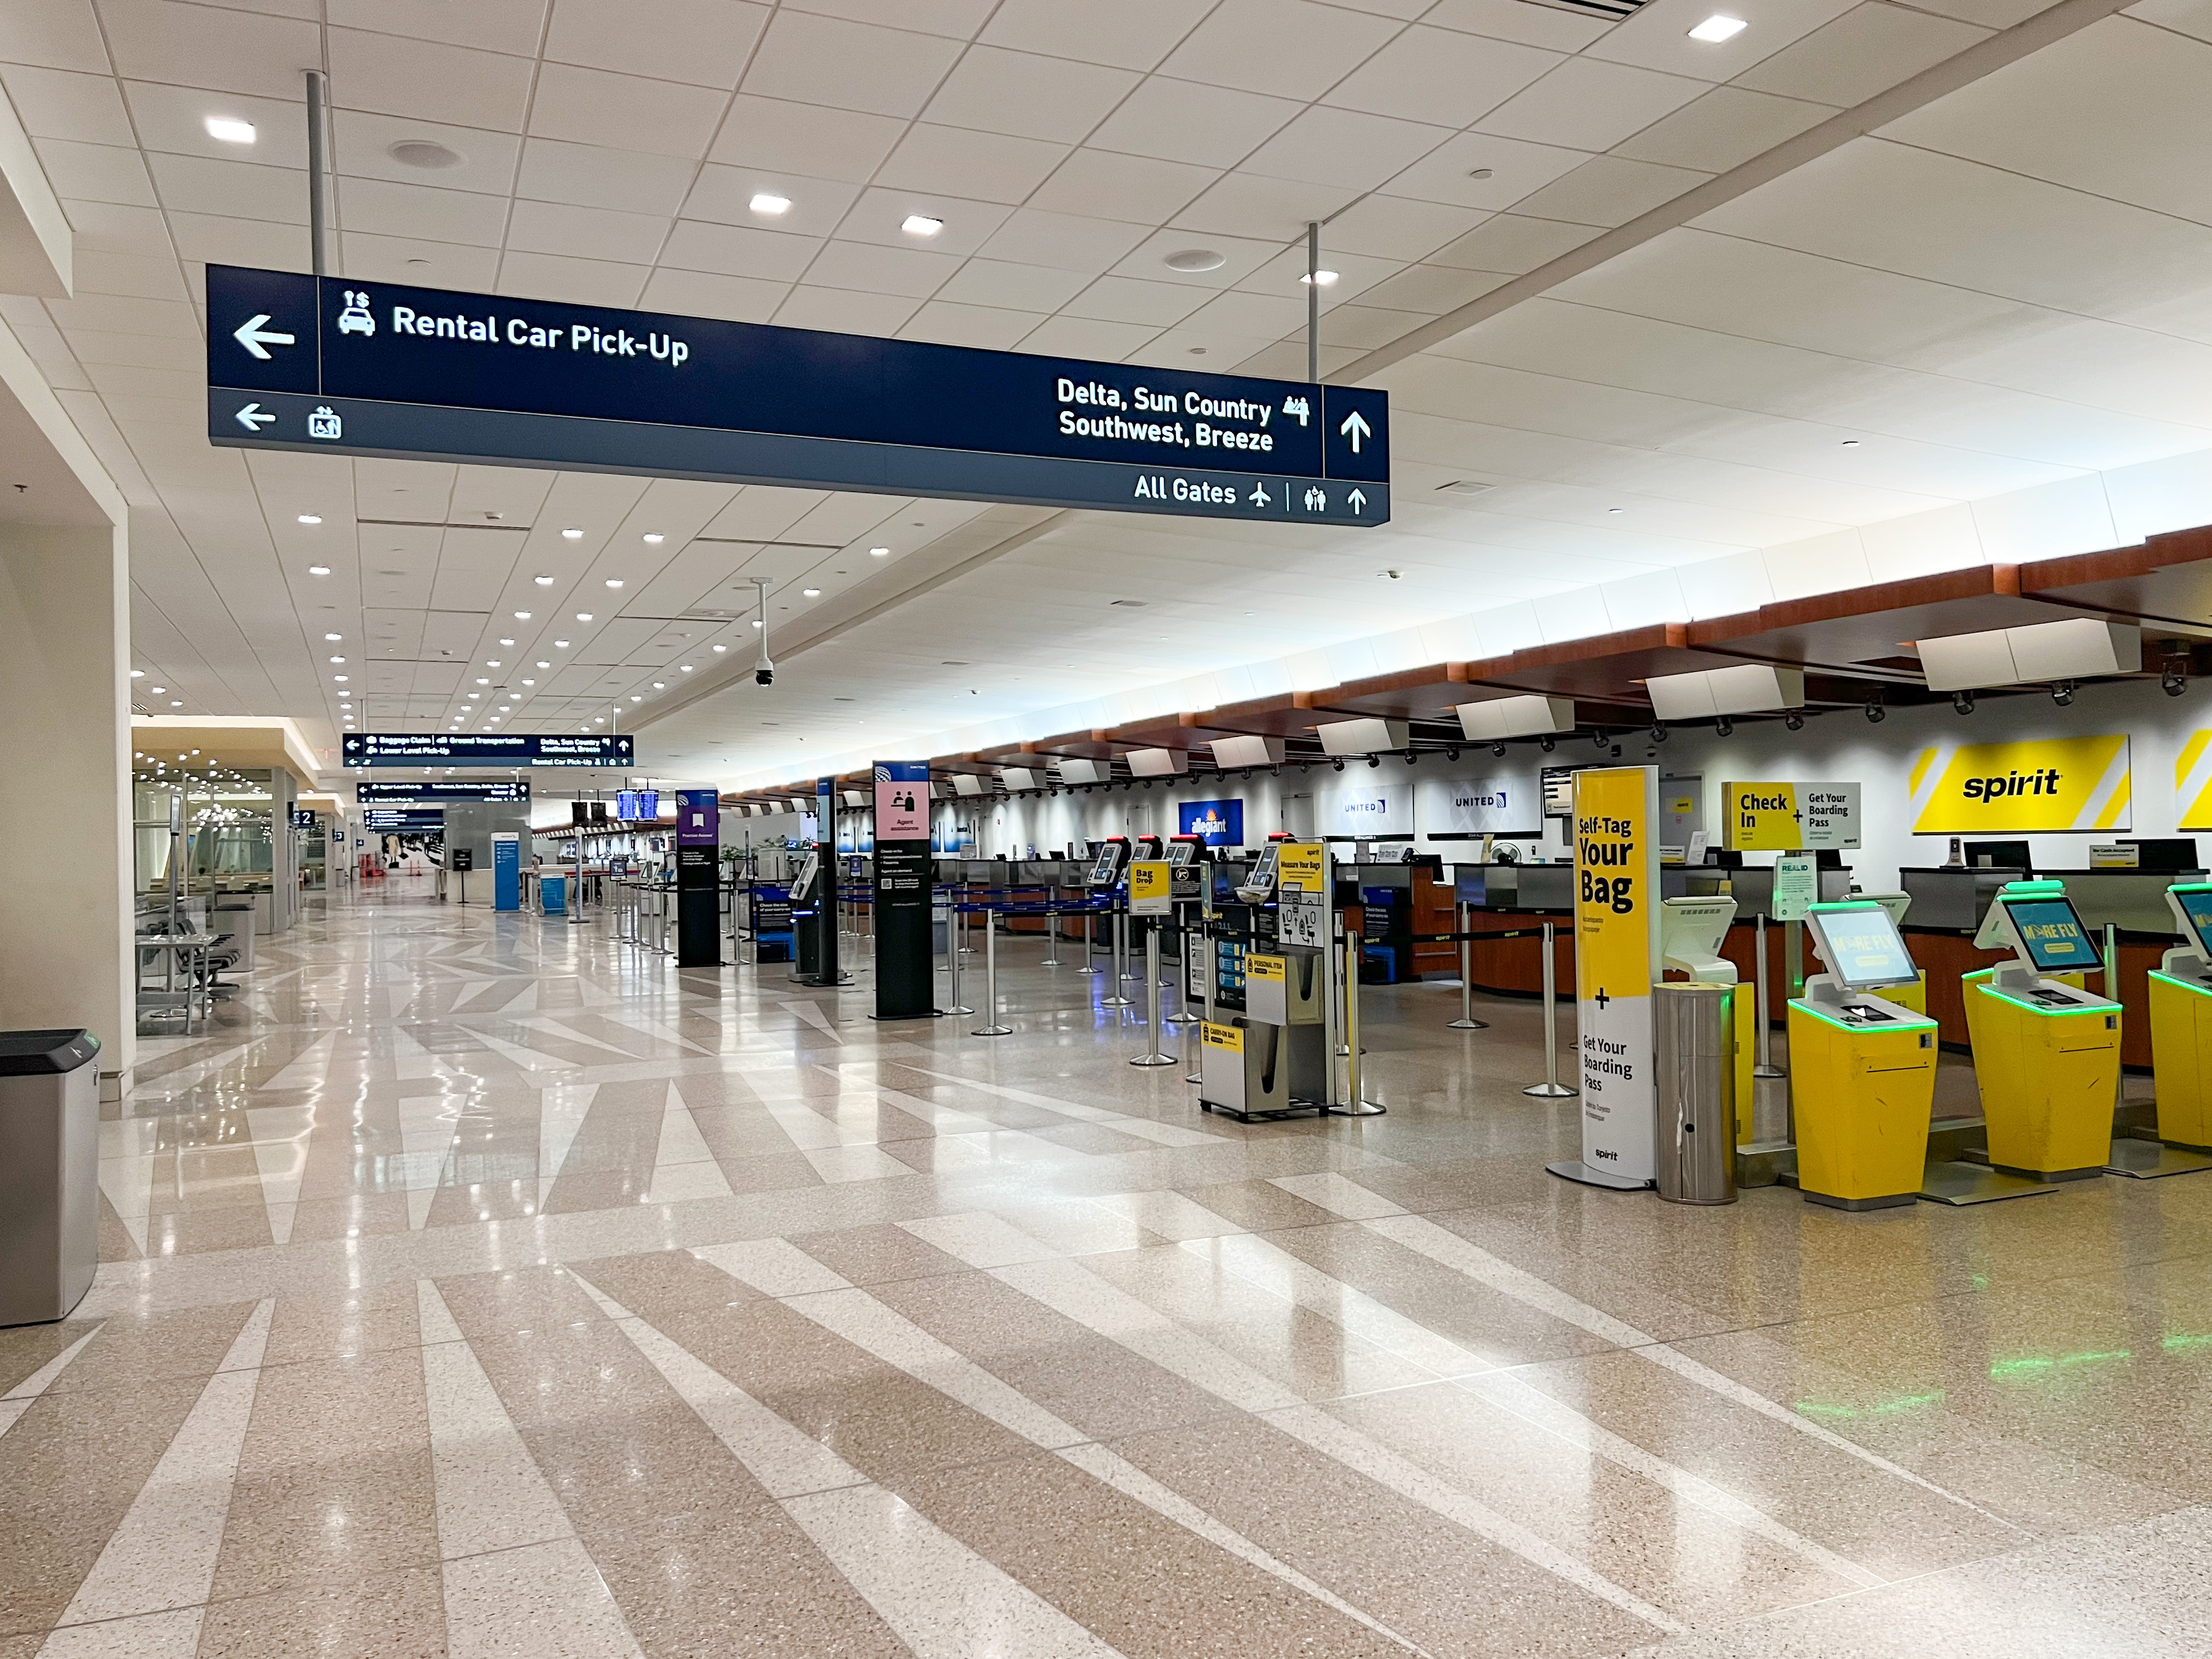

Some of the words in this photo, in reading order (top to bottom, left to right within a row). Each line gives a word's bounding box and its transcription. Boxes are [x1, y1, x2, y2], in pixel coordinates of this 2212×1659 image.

[394, 306, 499, 342] Rental
[508, 319, 564, 348] Car
[572, 325, 688, 366] Pick-Up
[1058, 378, 1127, 412] Delta,
[1134, 386, 1177, 413] Sun
[1185, 391, 1271, 427] Country
[1059, 411, 1190, 448] Southwest,
[1196, 422, 1273, 451] Breeze
[1134, 475, 1167, 499] All
[1173, 478, 1236, 504] Gates
[1963, 769, 2061, 804] spirit
[1456, 796, 1494, 807] UNITED
[1740, 793, 1788, 810] Check
[1809, 793, 1824, 803] Get
[1826, 793, 1847, 803] Your
[1345, 803, 1376, 812] UNITED
[1809, 804, 1849, 817] Boarding
[302, 812, 310, 823] 2
[1741, 812, 1755, 828] In
[1809, 818, 1829, 827] Pass
[1192, 817, 1226, 837] allegiant
[1579, 816, 1632, 838] Self-Tag
[1579, 837, 1634, 866] Your
[1136, 869, 1153, 878] Bag
[1581, 869, 1633, 914] Bag
[2057, 923, 2078, 937] FLY
[1872, 934, 1894, 950] FLY
[1583, 1034, 1596, 1051] Get
[1597, 1038, 1627, 1056] Your
[1584, 1053, 1633, 1080] Boarding
[1584, 1073, 1602, 1091] Pass
[1595, 1149, 1619, 1162] spirit
